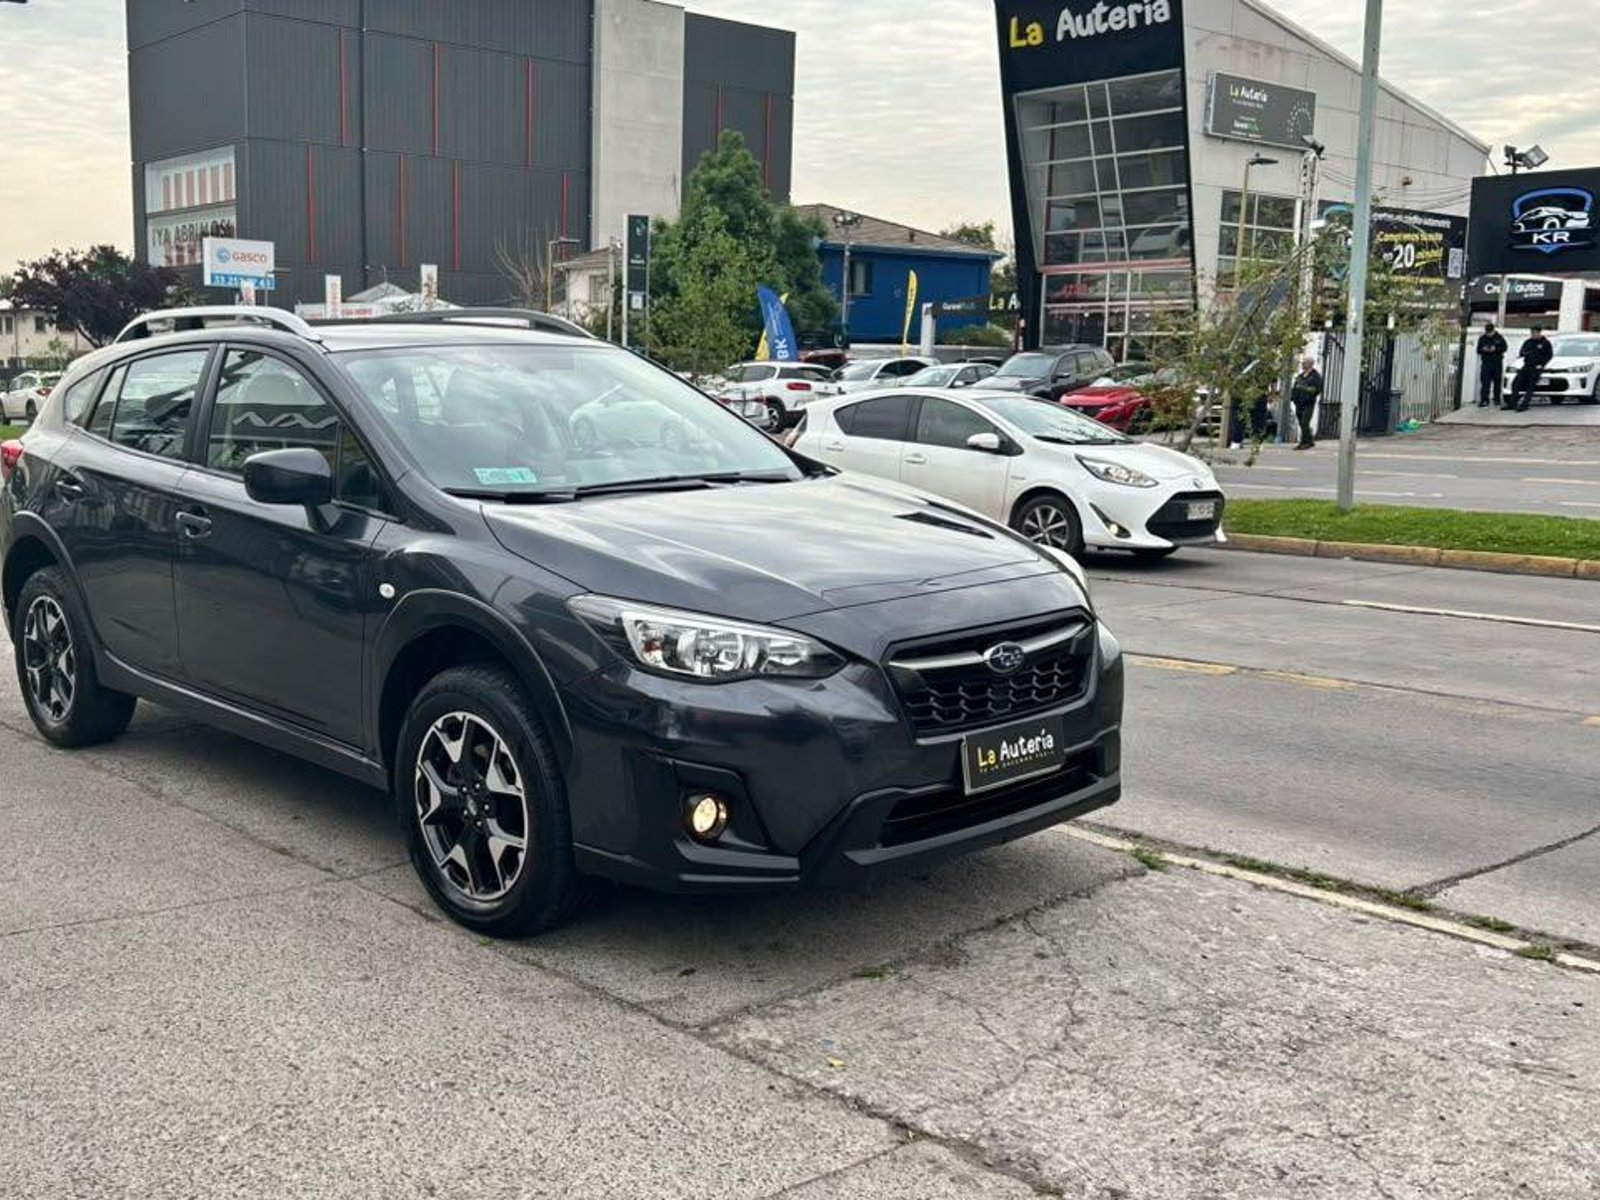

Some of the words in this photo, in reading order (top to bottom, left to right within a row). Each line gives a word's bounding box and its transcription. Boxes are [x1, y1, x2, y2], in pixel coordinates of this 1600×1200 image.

[1009, 16, 1044, 48] La
[1532, 231, 1570, 244] KR
[1393, 243, 1415, 270] 20
[988, 292, 1005, 311] La
[976, 746, 997, 768] La
[1000, 728, 1054, 762] Autería
